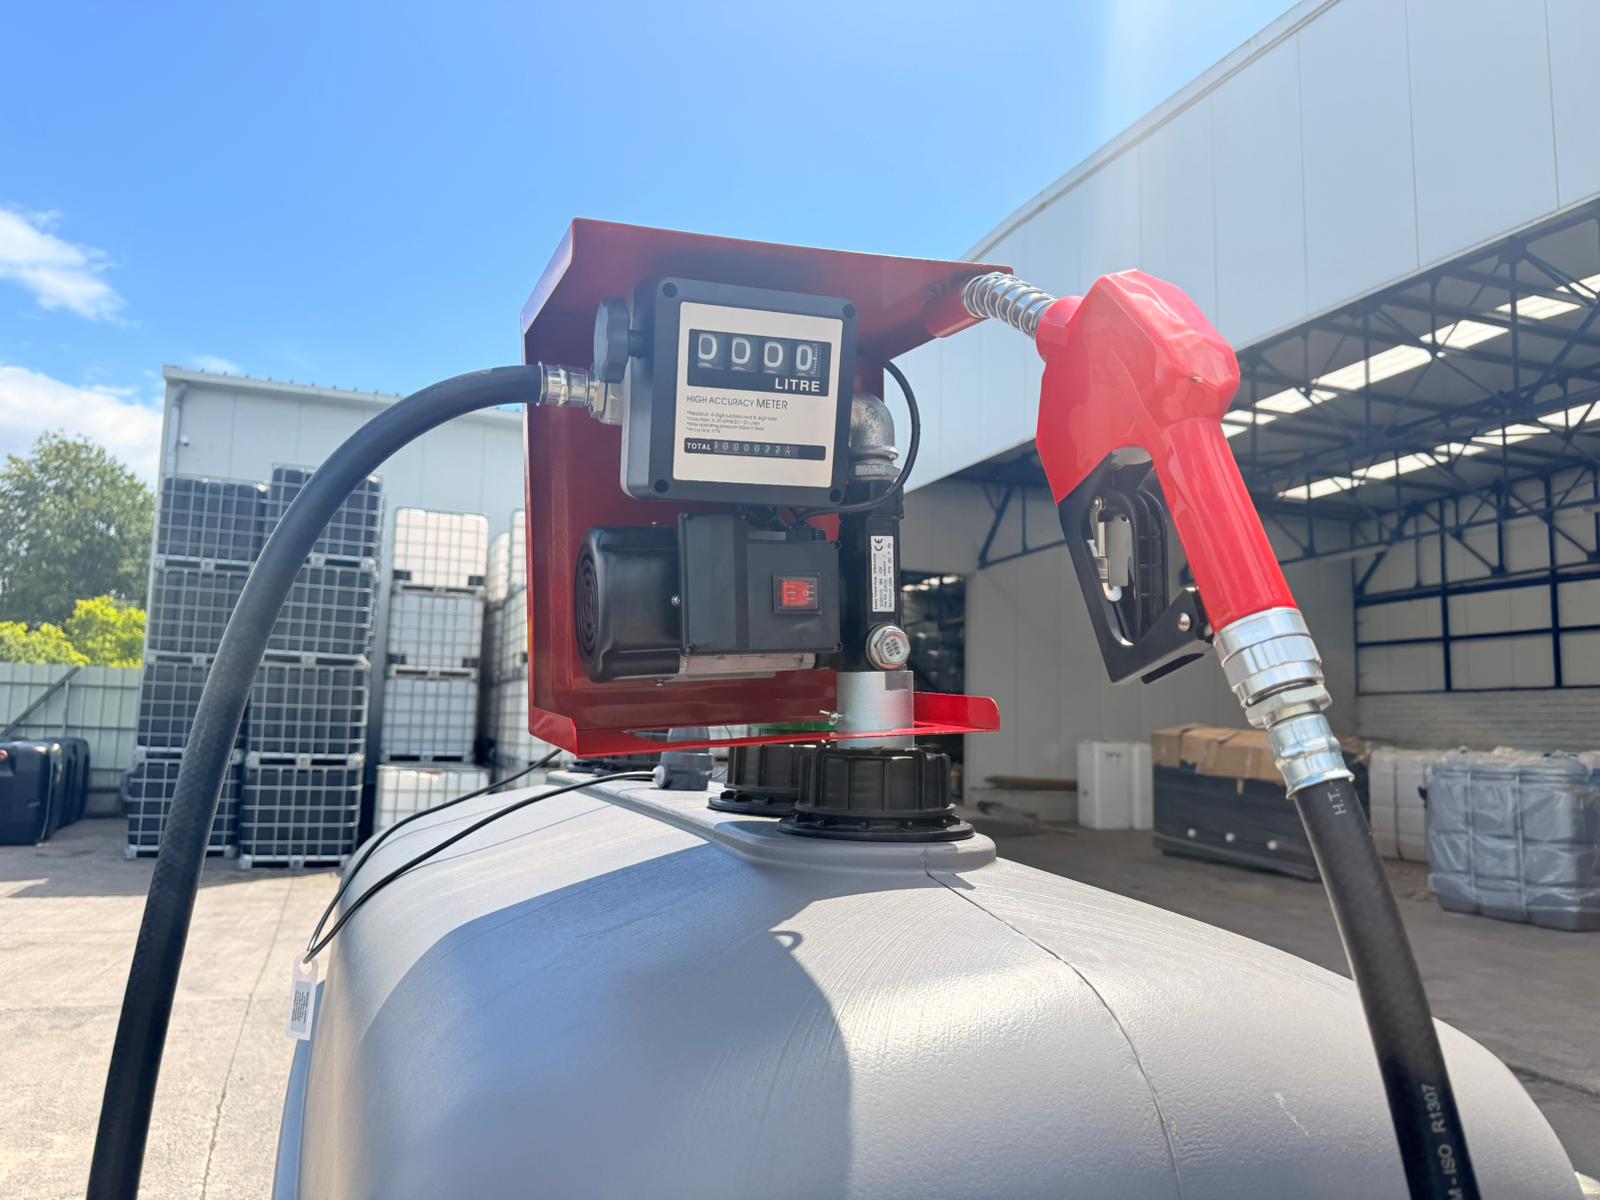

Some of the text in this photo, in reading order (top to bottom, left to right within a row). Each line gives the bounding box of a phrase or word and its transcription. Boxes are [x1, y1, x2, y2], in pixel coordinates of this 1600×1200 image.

[775, 378, 820, 393] LITRE
[686, 395, 788, 410] HIGH ACCURACY METER
[686, 442, 712, 451] TOTAL
[1421, 1083, 1447, 1133] R1307
